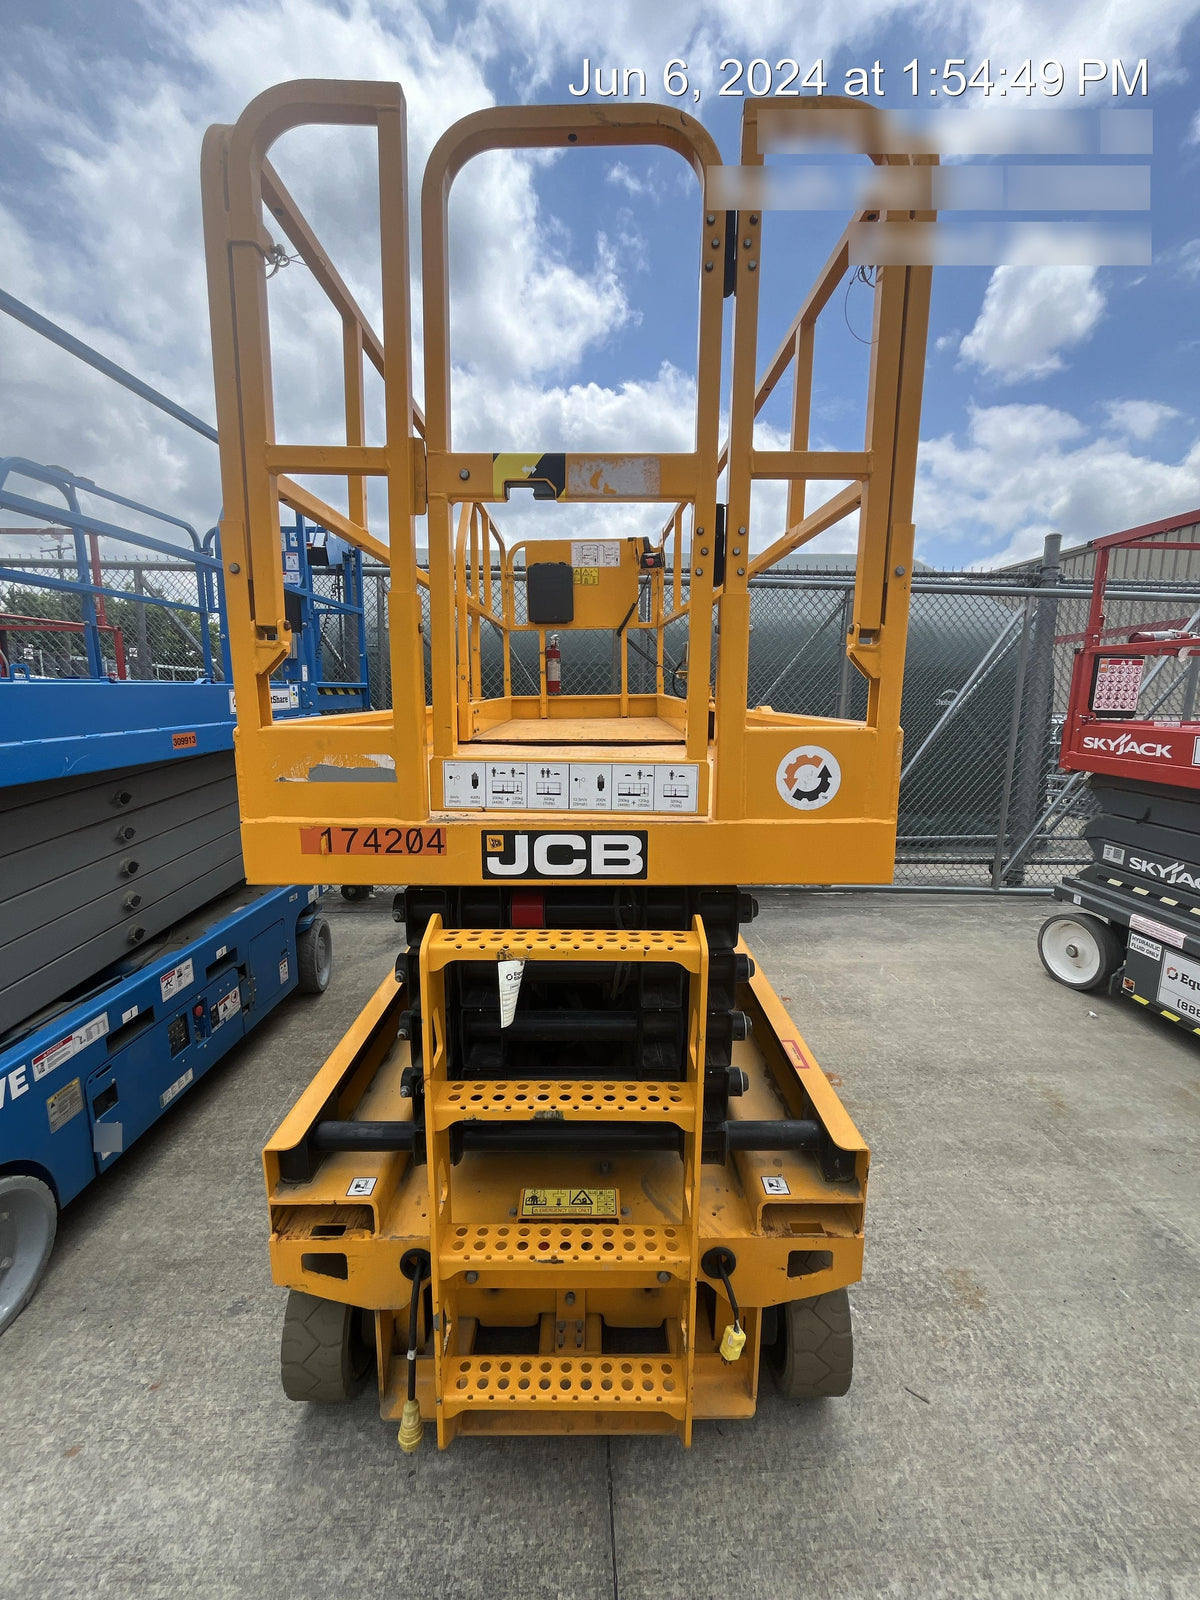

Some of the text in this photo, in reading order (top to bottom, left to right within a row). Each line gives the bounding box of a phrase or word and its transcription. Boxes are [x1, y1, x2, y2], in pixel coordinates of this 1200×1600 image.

[172, 735, 197, 746] 309913
[1083, 733, 1172, 759] SKYJACK
[320, 827, 445, 854] 174204
[486, 834, 644, 875] JCB
[1131, 935, 1160, 952] HYDRAULIC
[1131, 942, 1159, 958] FLUID ONLY
